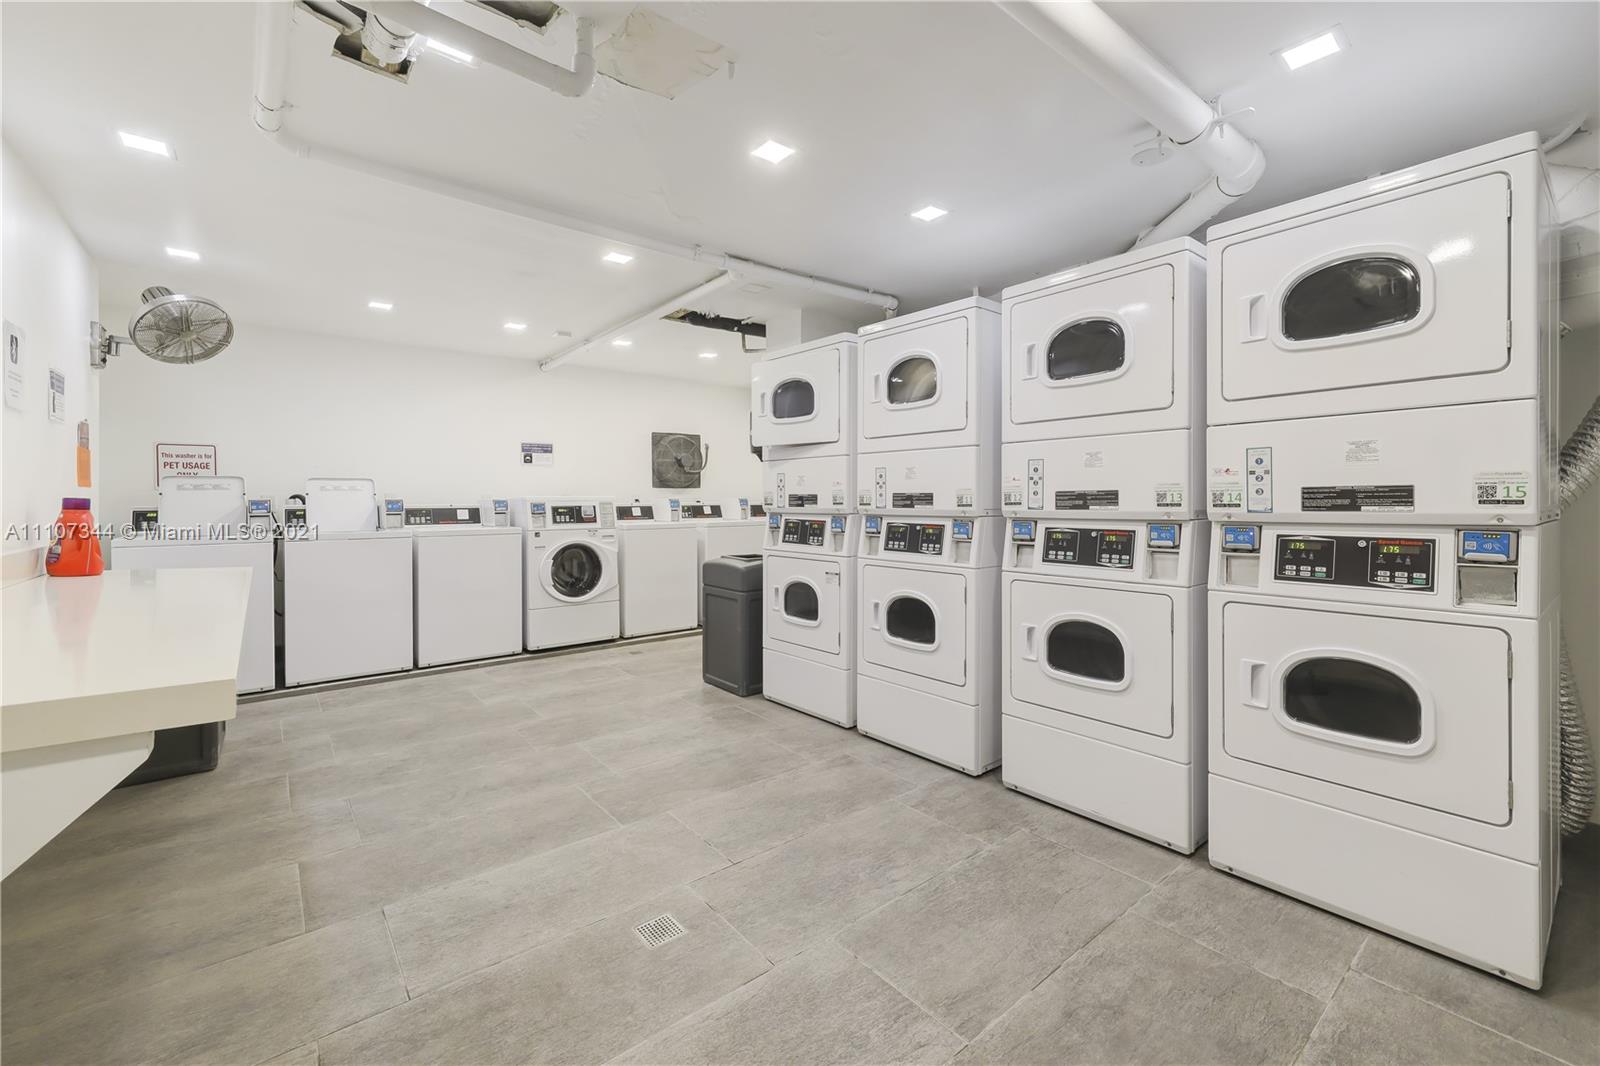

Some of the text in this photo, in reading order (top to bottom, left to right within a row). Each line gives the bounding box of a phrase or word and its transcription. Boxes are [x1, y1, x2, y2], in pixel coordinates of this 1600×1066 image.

[163, 461, 211, 470] PET USAGE
[1170, 492, 1183, 503] 13
[1227, 492, 1242, 503] 14
[1503, 485, 1527, 499] 15
